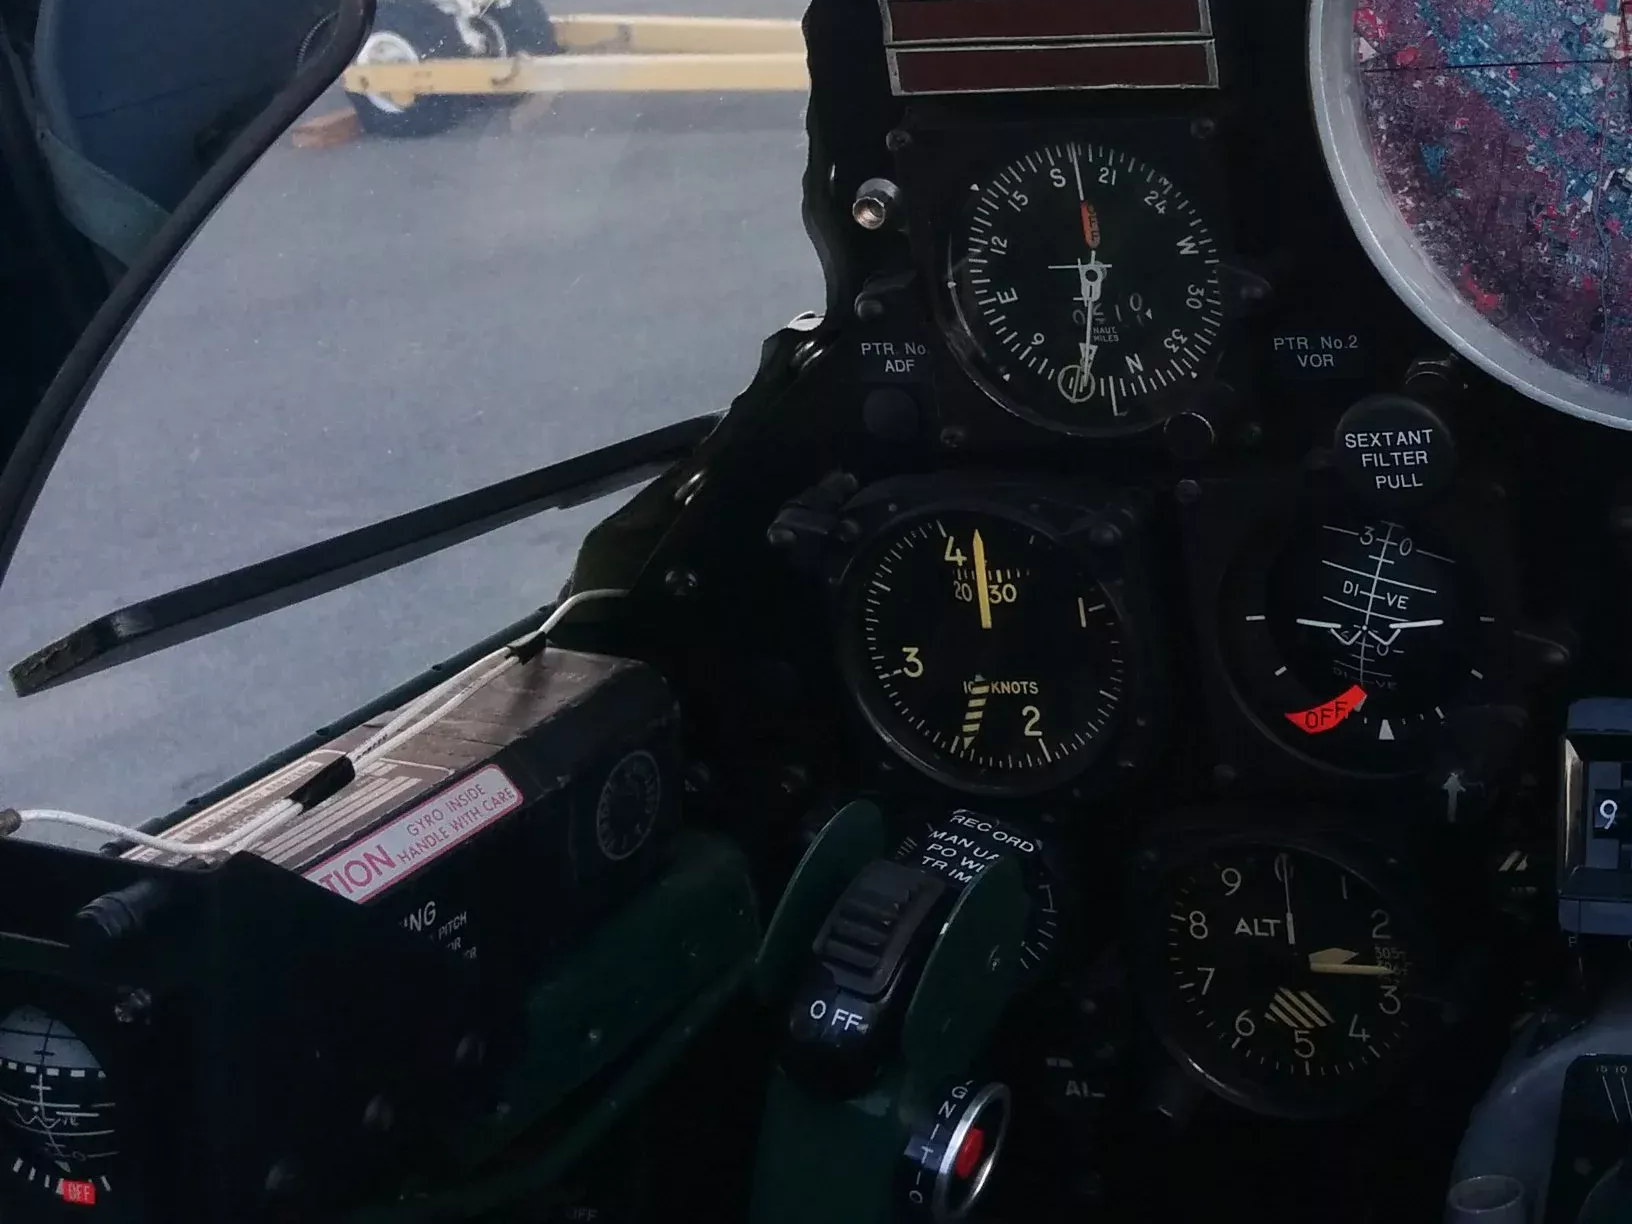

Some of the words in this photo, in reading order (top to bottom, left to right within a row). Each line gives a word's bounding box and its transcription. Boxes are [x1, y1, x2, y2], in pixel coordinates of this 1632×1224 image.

[1050, 168, 1067, 188] S
[1098, 167, 1116, 186] 21
[1008, 190, 1028, 212] 15
[1144, 190, 1166, 214] 24
[990, 235, 1008, 255] 12
[997, 288, 1019, 304] E
[861, 342, 895, 356] PTR
[1273, 336, 1308, 351] PTR
[884, 360, 915, 373] ADF
[1125, 353, 1143, 374] N
[1296, 353, 1335, 368] VOR
[1344, 428, 1434, 449] SEXTANT
[1361, 450, 1429, 468] FILTER
[1374, 474, 1423, 490] PULL
[944, 536, 967, 566] 4
[953, 581, 972, 602] 20
[988, 583, 1017, 604] 30
[901, 647, 924, 678] 3
[991, 681, 1039, 695] KNOTS
[1022, 705, 1043, 736] 2
[1305, 701, 1348, 728] OFF
[406, 808, 444, 837] GYRO
[446, 784, 486, 813] INSIDE
[396, 828, 449, 865] HANDLE
[451, 807, 481, 833] WITH
[483, 787, 515, 816] CARE
[1221, 867, 1242, 896] 9
[1189, 910, 1208, 940] 8
[1234, 917, 1282, 937] ALT
[1371, 908, 1391, 940] 2
[1197, 967, 1215, 995] 7
[1379, 985, 1401, 1015] 3
[1235, 1009, 1255, 1037] 6
[1348, 1013, 1371, 1042] 4
[1293, 1029, 1315, 1058] 5
